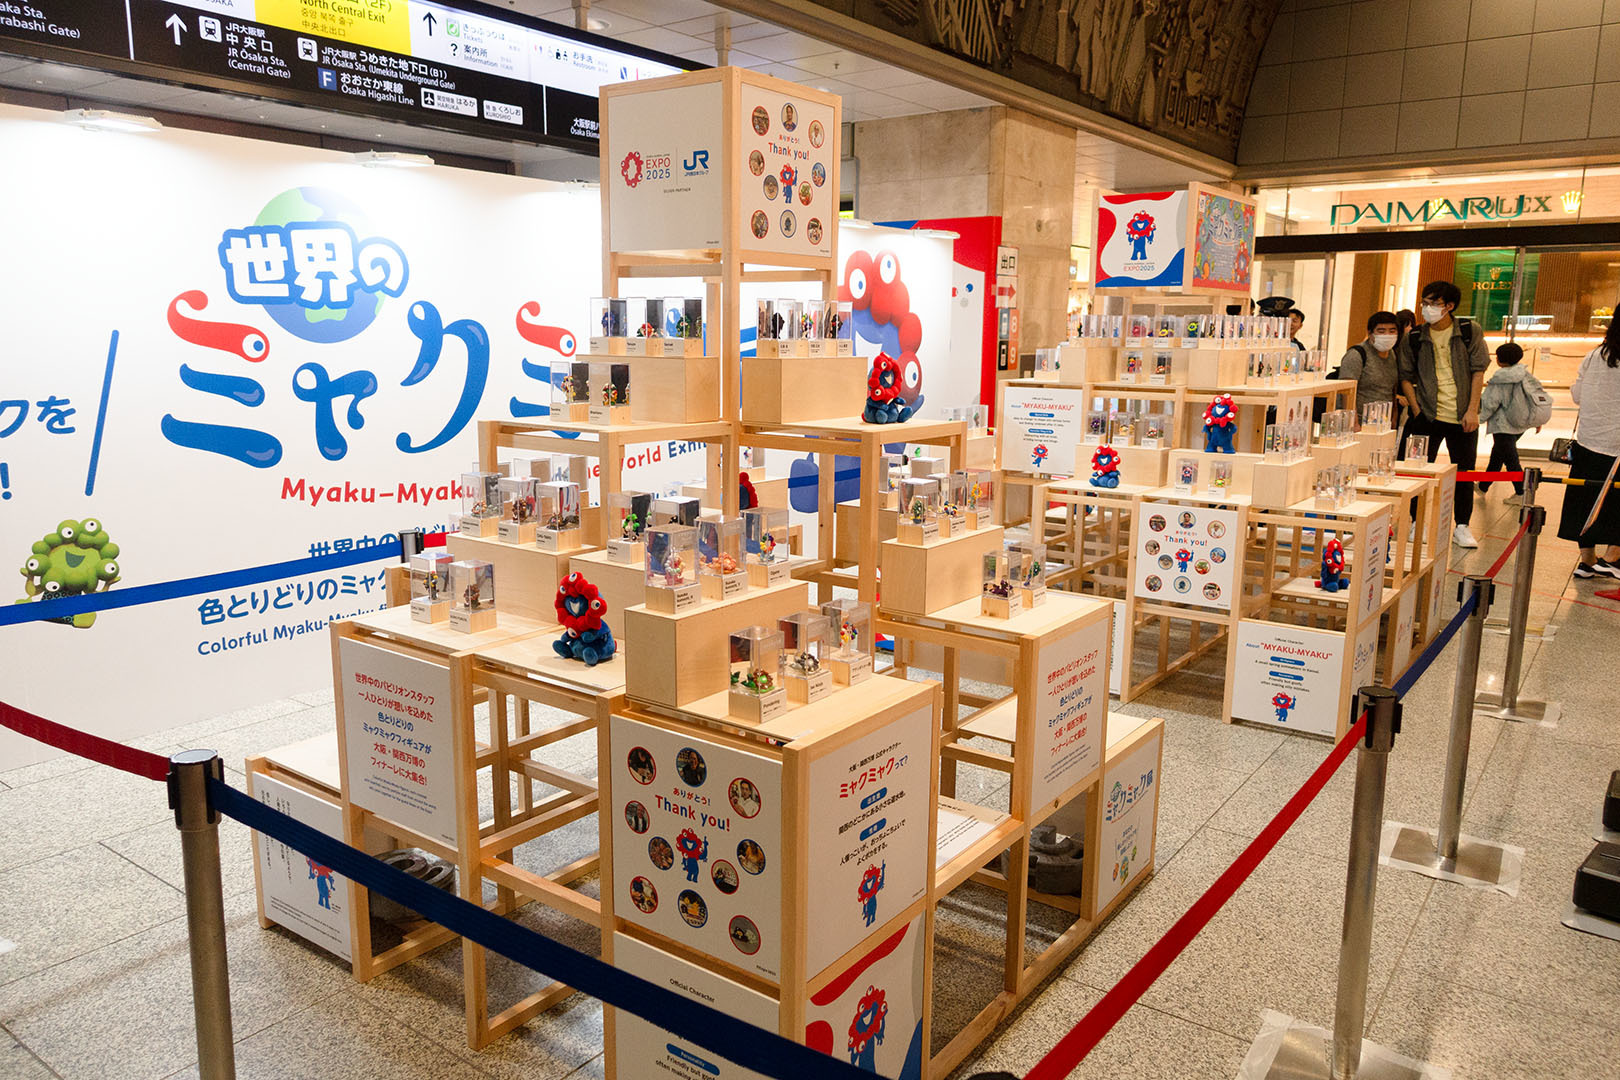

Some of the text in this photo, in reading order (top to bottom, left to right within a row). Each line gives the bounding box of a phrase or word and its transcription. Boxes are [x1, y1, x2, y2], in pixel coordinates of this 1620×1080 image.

[24, 6, 47, 20] Sta.
[331, 2, 366, 19] Central
[368, 10, 386, 24] Exit
[48, 23, 81, 39] Gate)
[226, 22, 266, 38] JR大阪駅
[301, 20, 346, 36] 中央北出口
[226, 33, 274, 54] 中央口
[463, 44, 488, 58] 案内所
[228, 48, 239, 58] JR
[270, 57, 287, 68] Sta.
[321, 46, 357, 60] JR大阪駅
[358, 50, 428, 74] うめきた地下口
[463, 55, 499, 67] Information
[228, 59, 291, 79] (Central Gate)
[322, 56, 331, 65] JR
[354, 62, 368, 72] Sta.
[369, 65, 398, 79] (Umekita
[399, 70, 439, 87] Underground
[440, 78, 456, 90] Gate)
[322, 72, 333, 87] F
[340, 72, 404, 94] おおさか東線
[367, 89, 397, 103] Higashi
[398, 94, 415, 106] Line
[437, 102, 460, 111] HARUKA
[456, 97, 476, 108] はるか
[498, 105, 521, 116] くろしお
[683, 150, 709, 170] JR
[768, 142, 810, 161] Thank you!
[645, 157, 671, 169] EXPO
[645, 168, 671, 181] 2025
[1330, 194, 1526, 226] DAIMARU
[221, 224, 408, 307] 世界の
[620, 444, 662, 473] orld
[1164, 534, 1208, 547] Thank you!
[198, 628, 268, 656] Colorful
[354, 672, 436, 706] 世界中のパビリオンスタッフ
[377, 711, 415, 733] 色とりどりの
[362, 722, 433, 755] ミャクミャクフィギュアが
[372, 741, 426, 770] 大阪・関西万博の
[369, 756, 429, 786] フィナーレに大集合!
[672, 786, 711, 807] ありがとう!
[654, 794, 731, 832] Thank you!
[669, 978, 716, 1004] Official Character
[655, 1060, 671, 1071] often
[666, 1055, 690, 1072] Friendly
